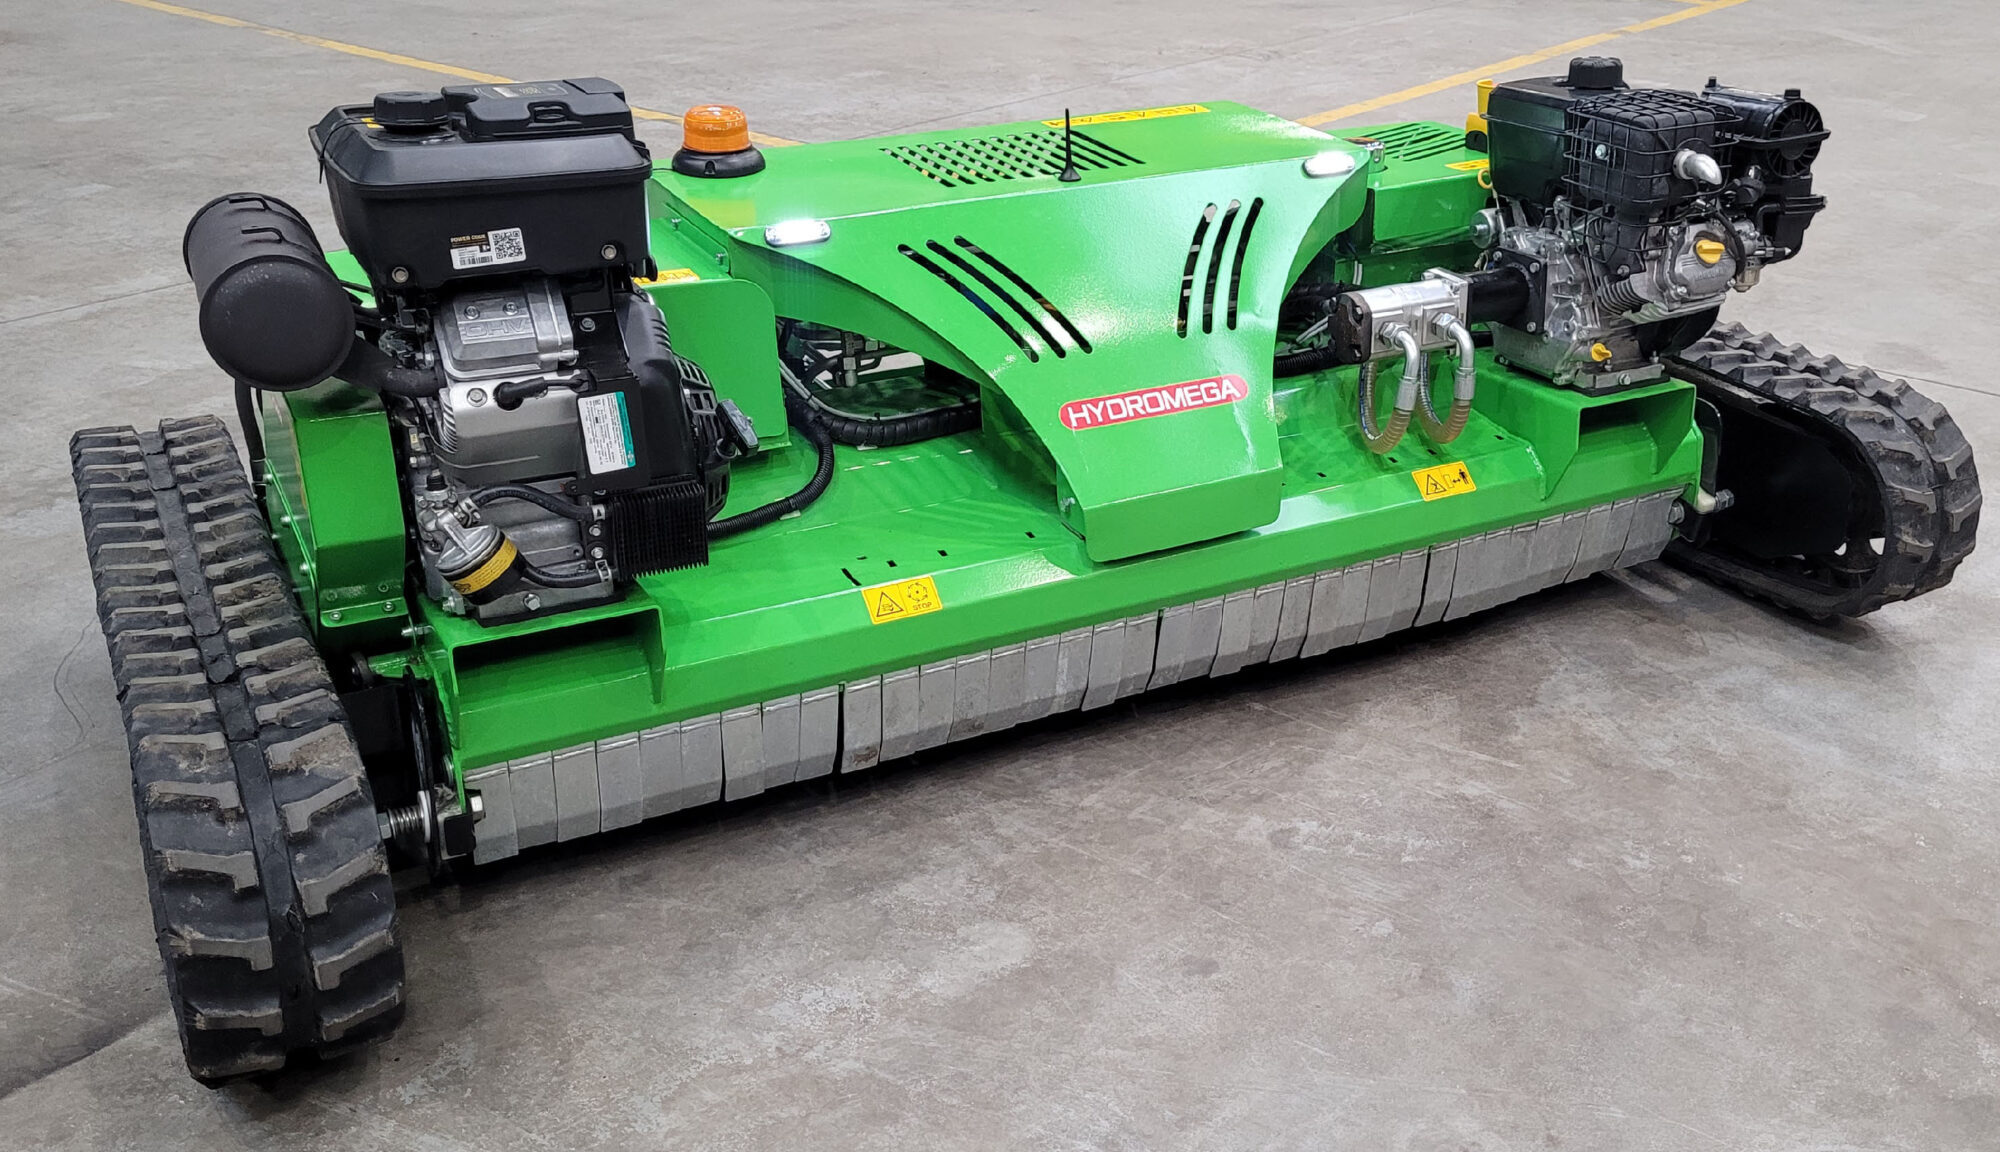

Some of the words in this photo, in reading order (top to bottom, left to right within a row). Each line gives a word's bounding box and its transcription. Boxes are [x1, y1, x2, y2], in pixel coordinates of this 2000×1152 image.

[465, 319, 527, 337] OHV
[1067, 378, 1241, 427] HYDROMEGA
[912, 601, 932, 611] STOP
